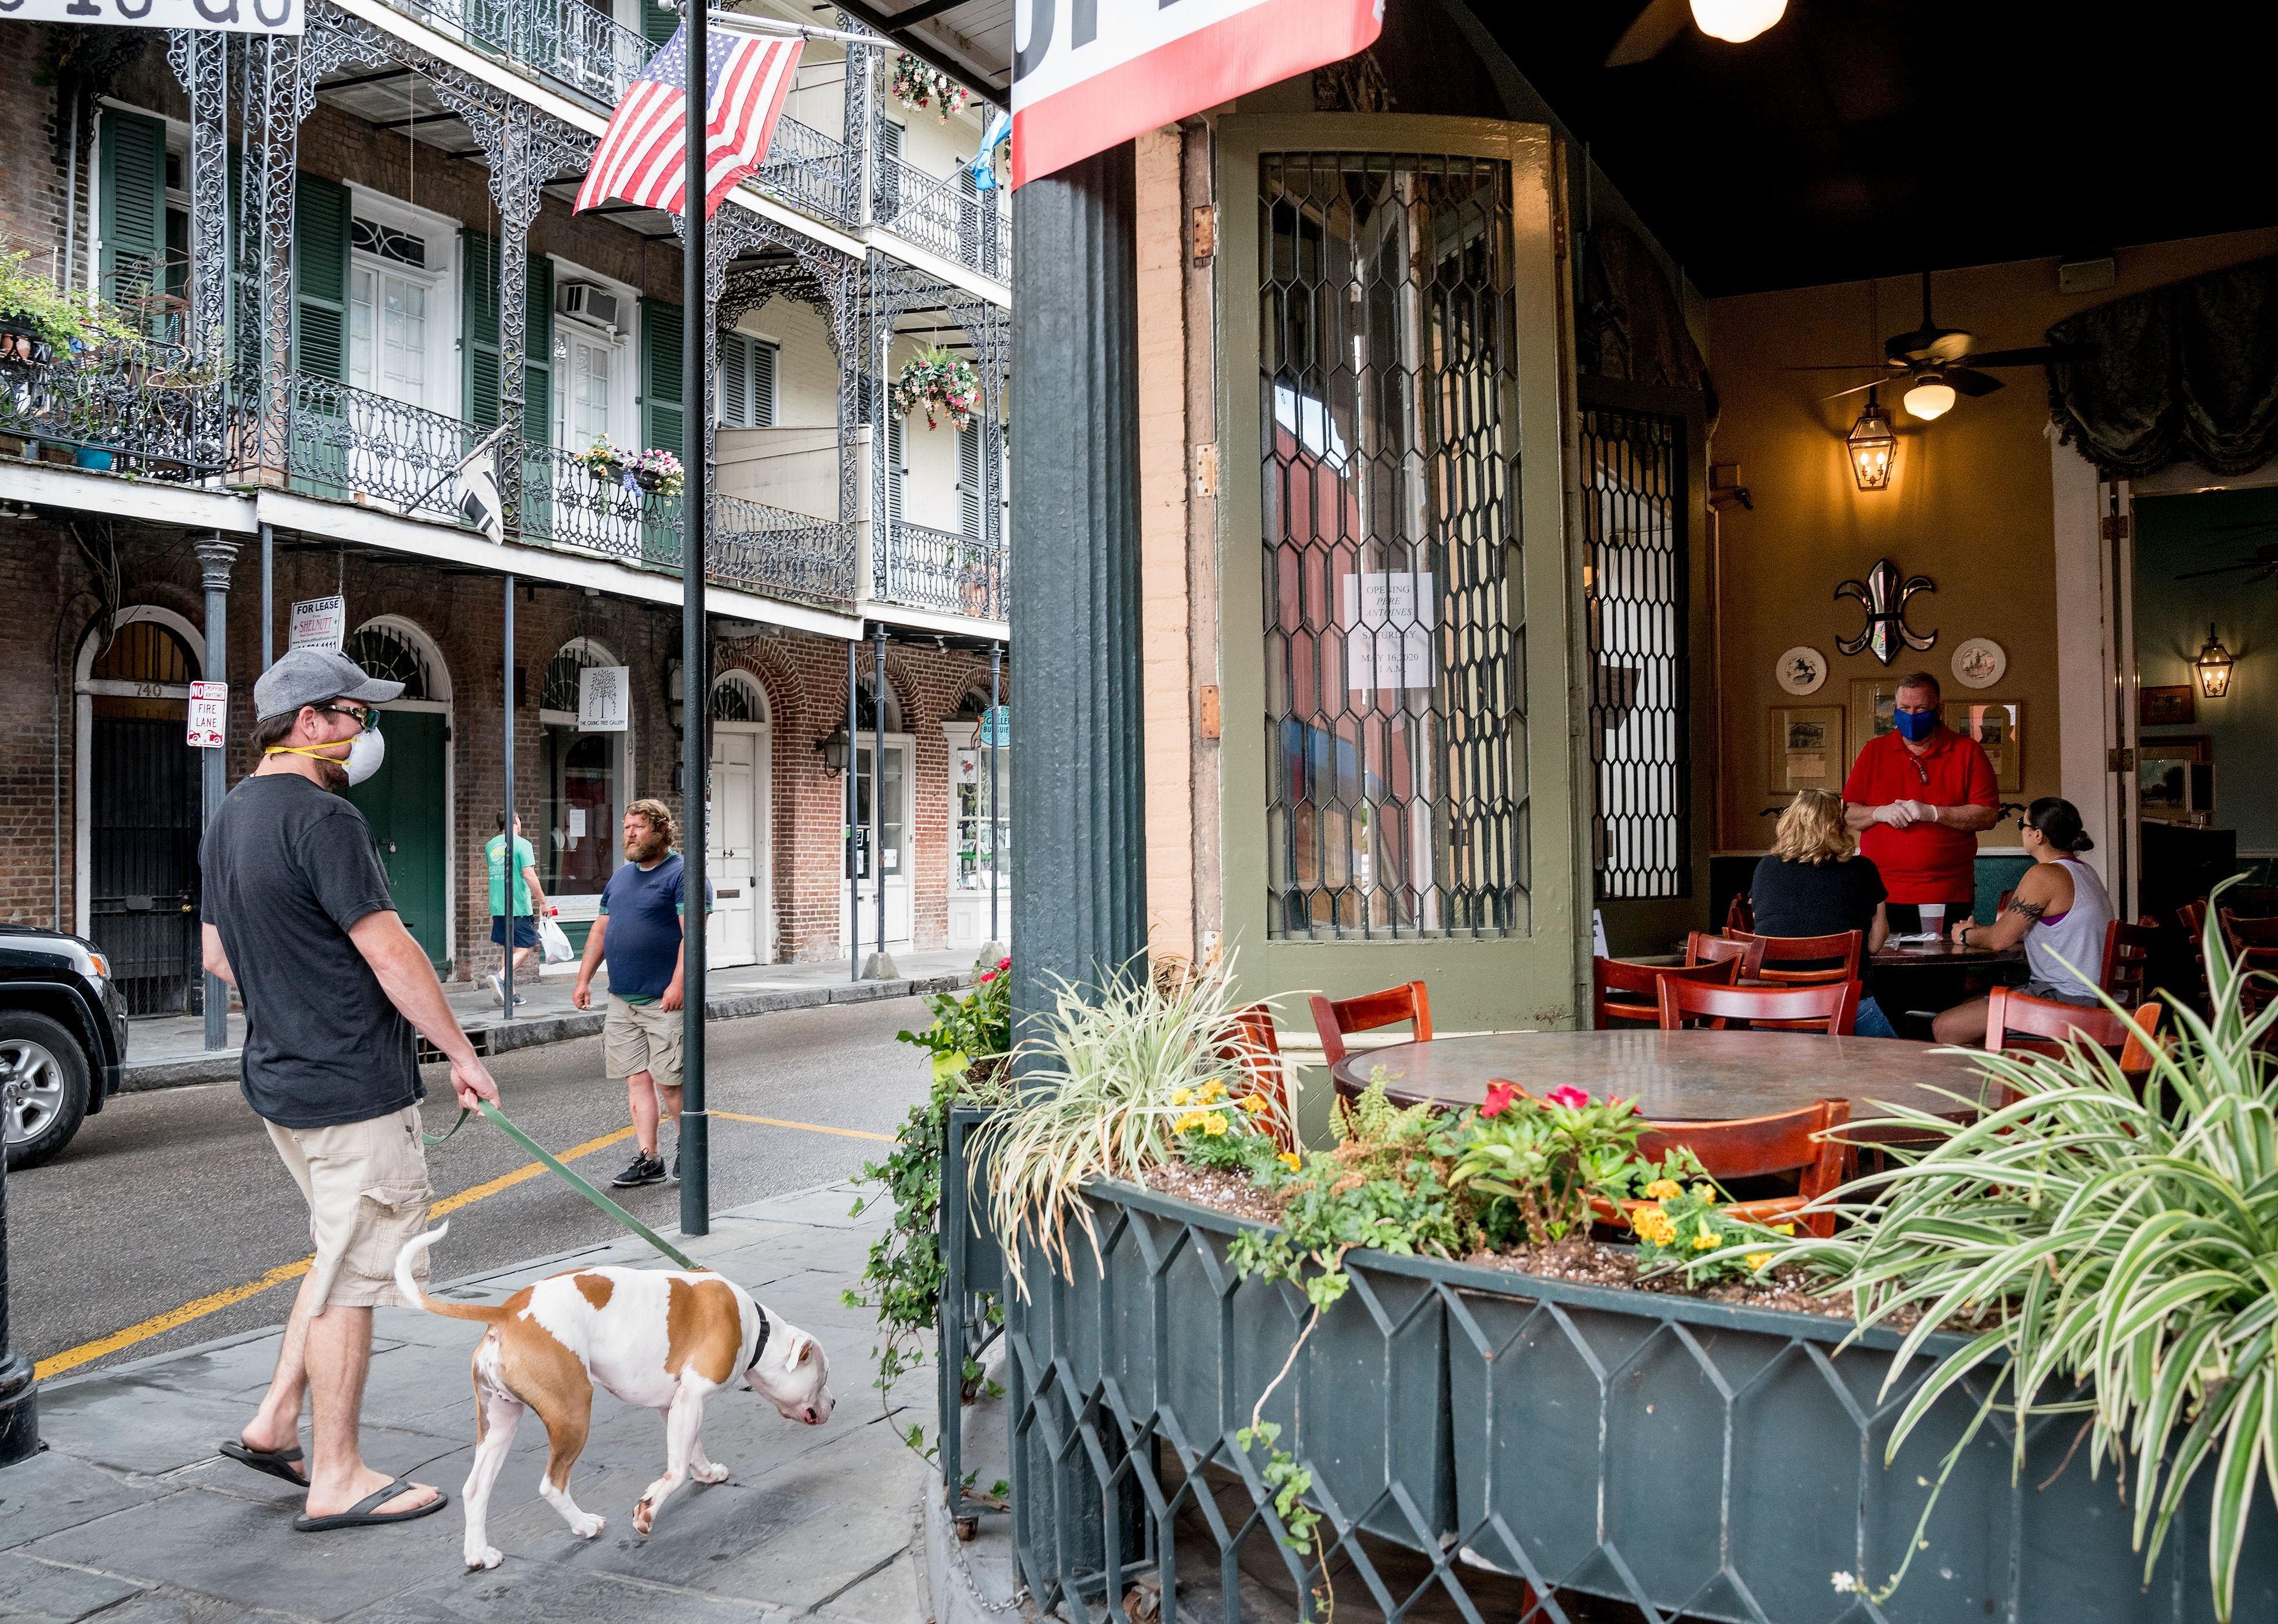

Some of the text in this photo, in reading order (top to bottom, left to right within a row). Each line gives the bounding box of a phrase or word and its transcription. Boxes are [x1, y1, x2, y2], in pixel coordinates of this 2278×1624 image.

[297, 600, 339, 615] FOR LEASE
[299, 617, 333, 633] SHELNUTT
[135, 684, 162, 696] 740
[191, 685, 204, 697] NO
[198, 704, 216, 714] FIRE
[196, 717, 217, 728] LANE
